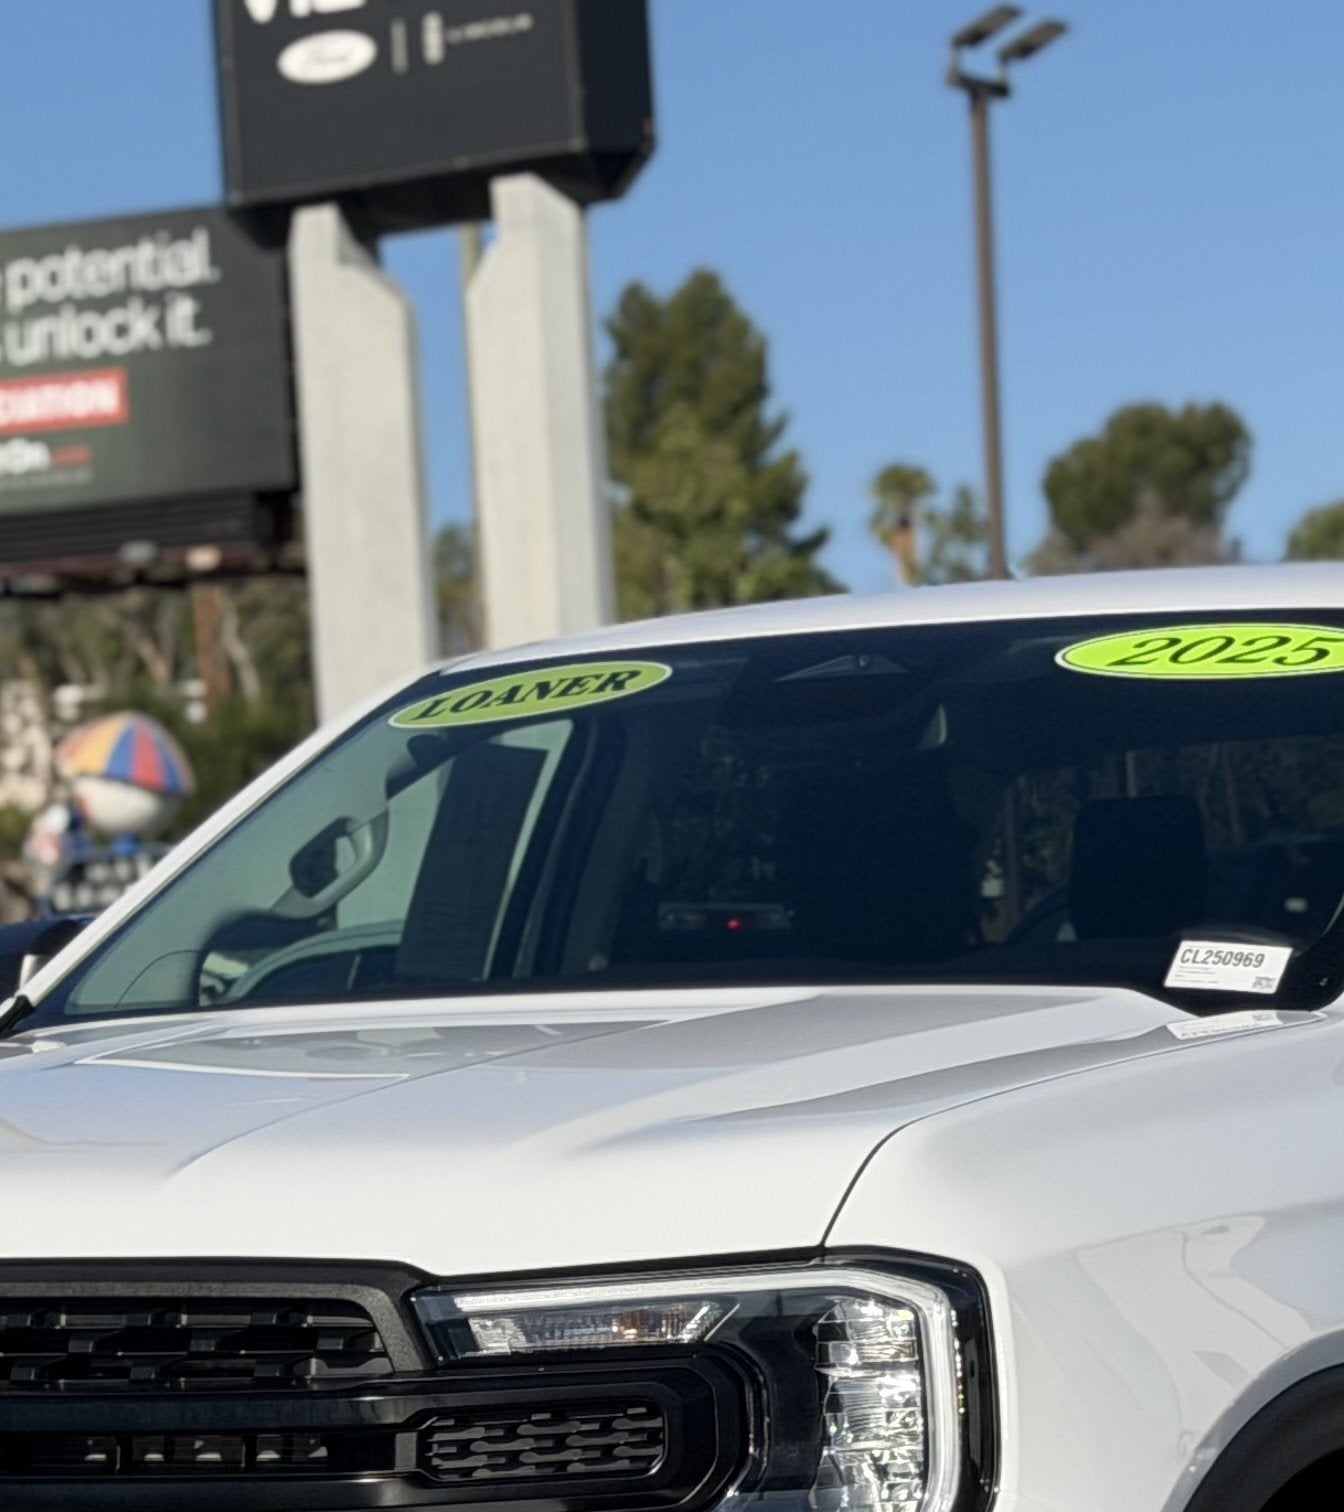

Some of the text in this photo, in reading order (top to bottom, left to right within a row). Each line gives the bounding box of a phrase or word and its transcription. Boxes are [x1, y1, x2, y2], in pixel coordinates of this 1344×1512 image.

[4, 296, 160, 366] unlock
[410, 669, 642, 721] LOANER
[1179, 948, 1266, 969] CL250969
